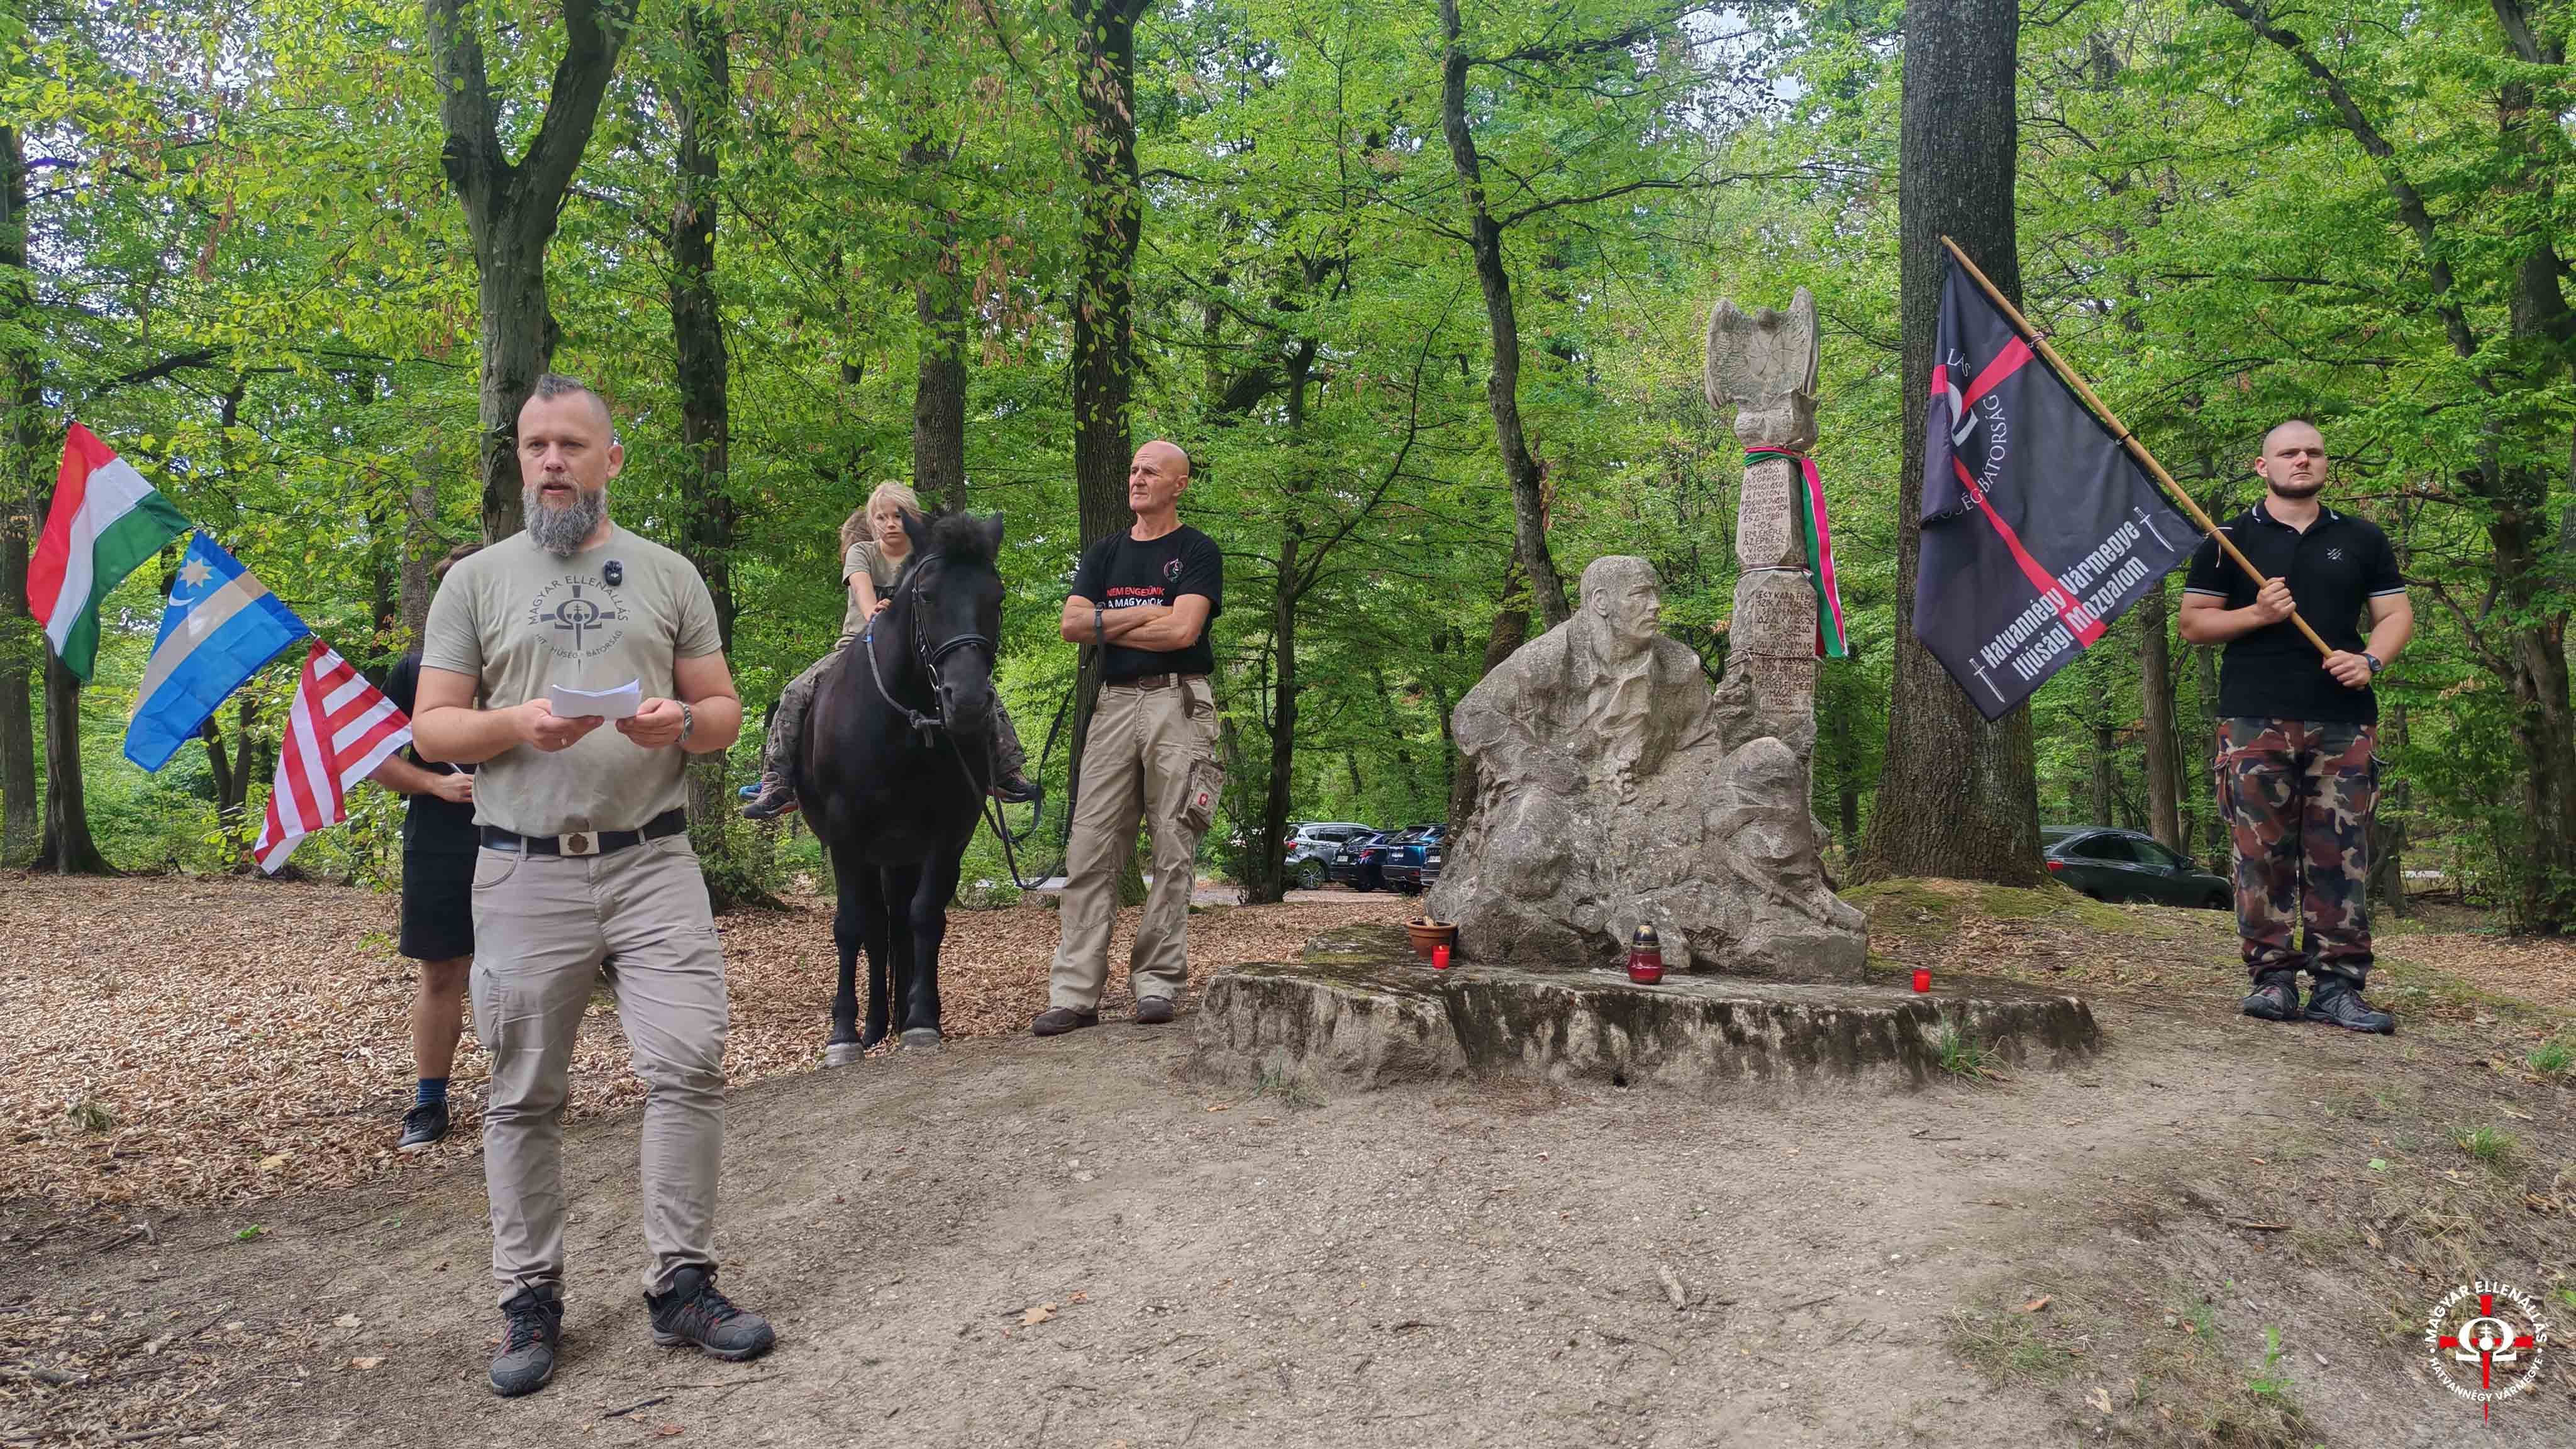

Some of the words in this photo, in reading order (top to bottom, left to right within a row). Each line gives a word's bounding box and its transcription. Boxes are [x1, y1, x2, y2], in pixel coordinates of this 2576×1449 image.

[1978, 394, 2007, 493] BÁTORSÁG
[528, 579, 562, 625] MAGYAR
[1108, 600, 1114, 609] A
[1980, 587, 2067, 669] Hatvannégy
[2058, 521, 2140, 596] Vármegye
[2065, 557, 2149, 633] Mozgalom
